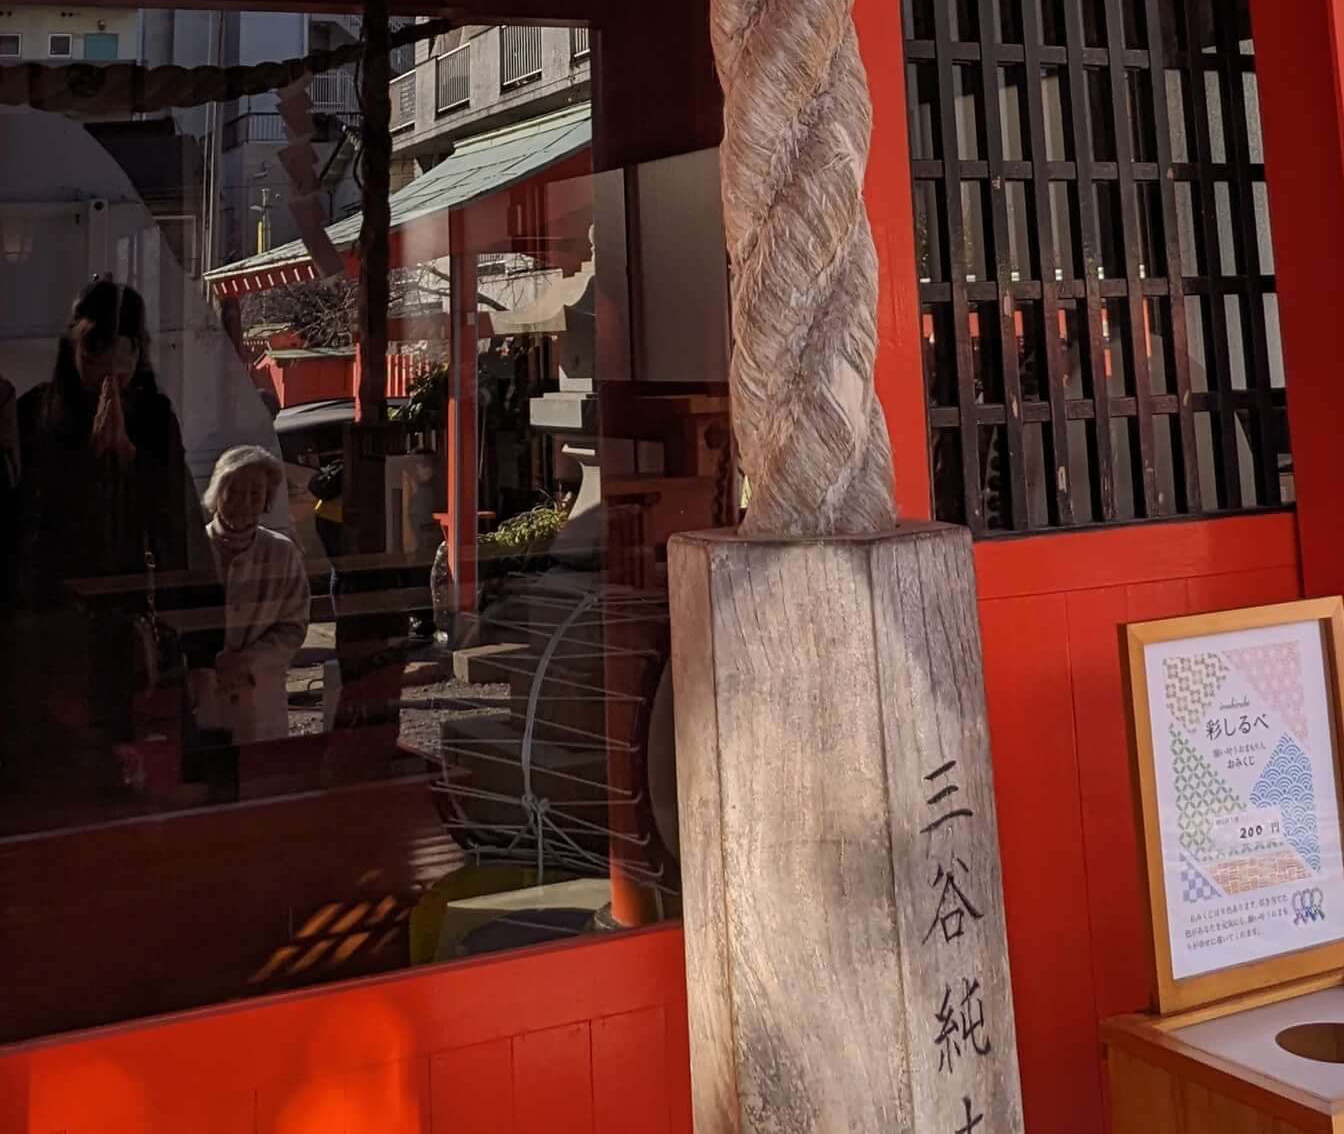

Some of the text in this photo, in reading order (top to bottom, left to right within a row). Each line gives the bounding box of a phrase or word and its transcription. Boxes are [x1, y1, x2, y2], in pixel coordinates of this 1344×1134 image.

[1205, 713, 1270, 741] 彩しるべ
[1239, 825, 1264, 839] 200
